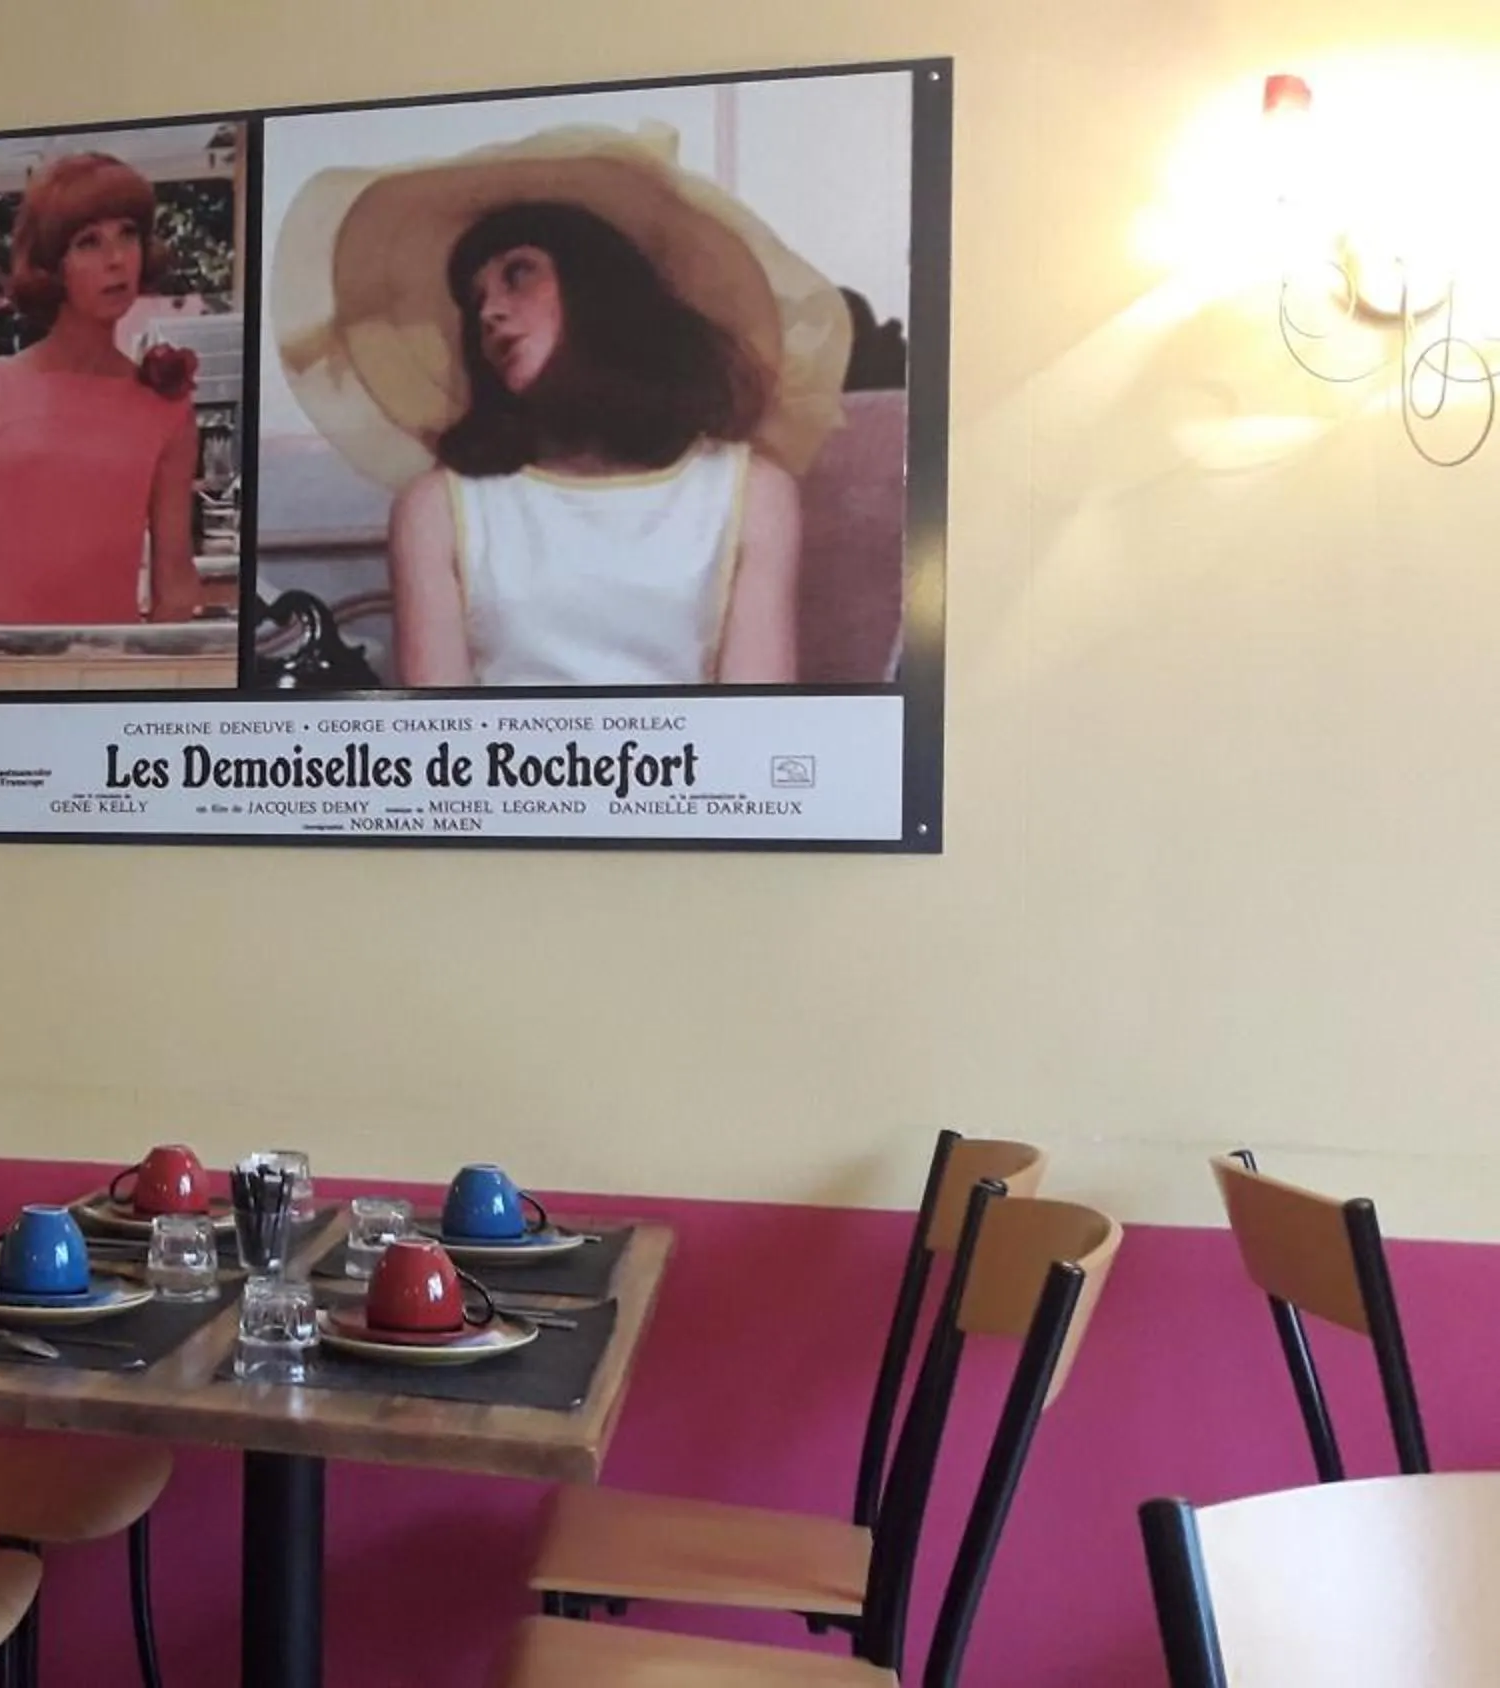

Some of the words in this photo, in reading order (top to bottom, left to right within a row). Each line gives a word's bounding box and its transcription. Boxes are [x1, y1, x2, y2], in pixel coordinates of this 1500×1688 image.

[124, 722, 211, 736] CATHERINE
[220, 721, 294, 734] DENEUVE
[318, 719, 385, 733] GEORGE
[393, 718, 473, 732] CHAKIRIS
[498, 717, 593, 733] FRANÇOISE
[603, 717, 686, 731] DORLEAC
[106, 744, 169, 788] Les
[182, 742, 412, 788] Demoiselles
[426, 742, 472, 787] de
[486, 740, 699, 798] Rochefort
[50, 800, 92, 813] GENE
[99, 800, 148, 813] KELLY
[248, 801, 317, 815] JACQUES
[323, 801, 369, 814] DEMY
[429, 801, 493, 813] MICHEL
[503, 801, 586, 814] LEGRAND
[609, 801, 697, 814] DANIELLE
[707, 801, 802, 814] DARRIEUX
[350, 817, 424, 831] NORMAN
[433, 818, 482, 831] MAEN
